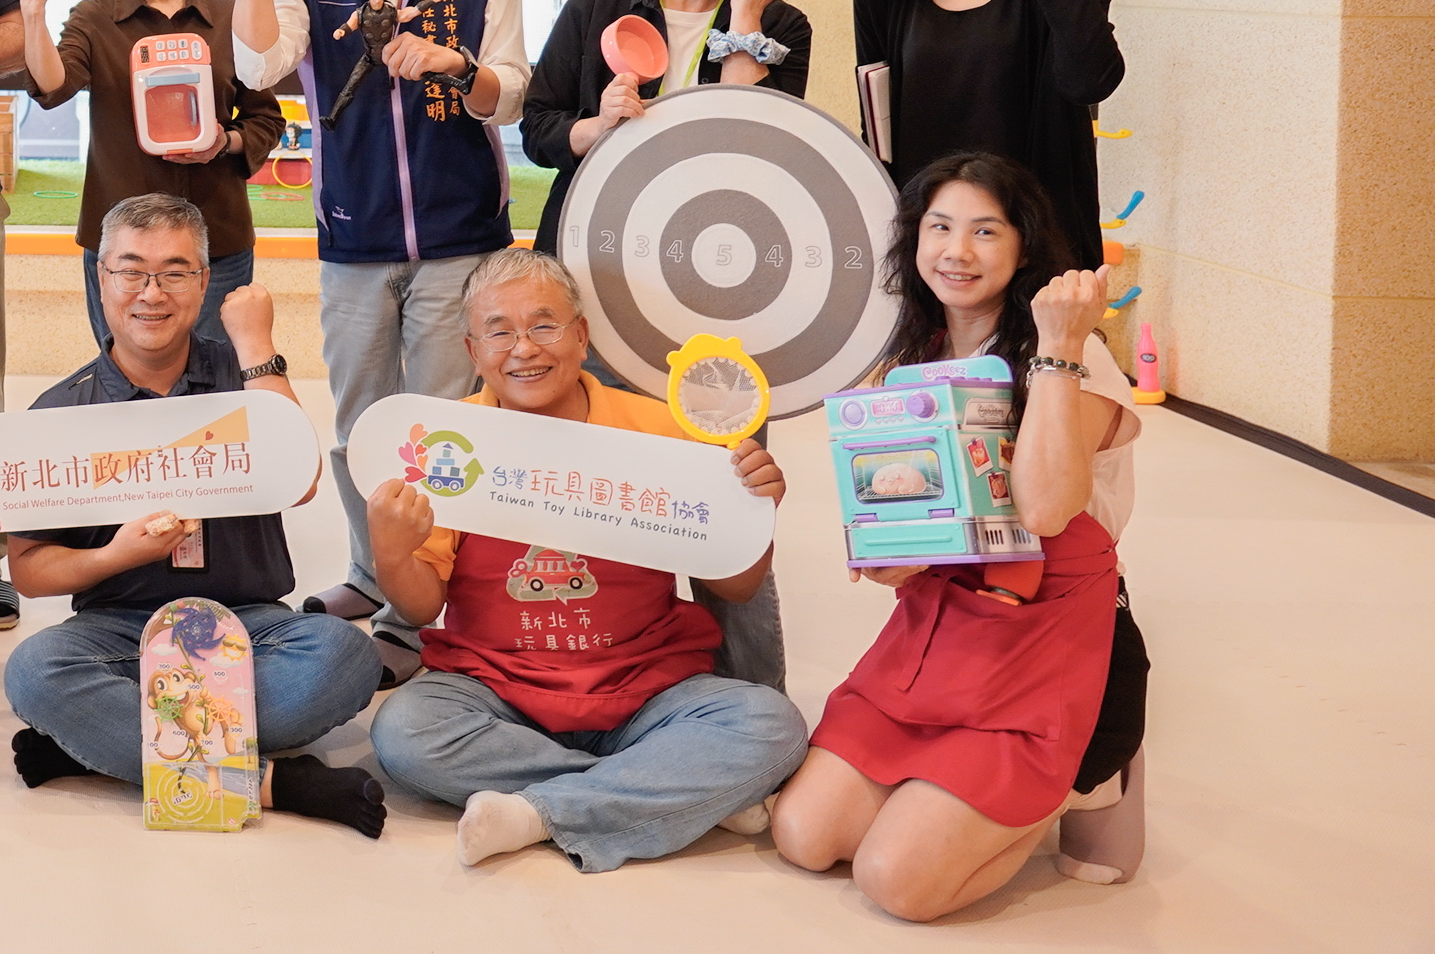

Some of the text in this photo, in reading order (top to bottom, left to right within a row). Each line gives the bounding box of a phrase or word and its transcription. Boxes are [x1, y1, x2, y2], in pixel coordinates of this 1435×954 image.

[569, 225, 863, 269] 1 2 3 4 5 4 3 2
[0, 442, 252, 493] 新北市政府社會局
[3, 499, 29, 510] Social
[31, 497, 65, 508] Welfare
[147, 489, 174, 500] Taipei
[176, 487, 194, 498] City
[195, 484, 254, 496] Government
[490, 491, 708, 541] Taiwan Toy Library Association
[492, 466, 710, 525] 台灣玩具圖書館協會
[520, 607, 591, 631] 新北市
[514, 632, 613, 651] 玩具銀行
